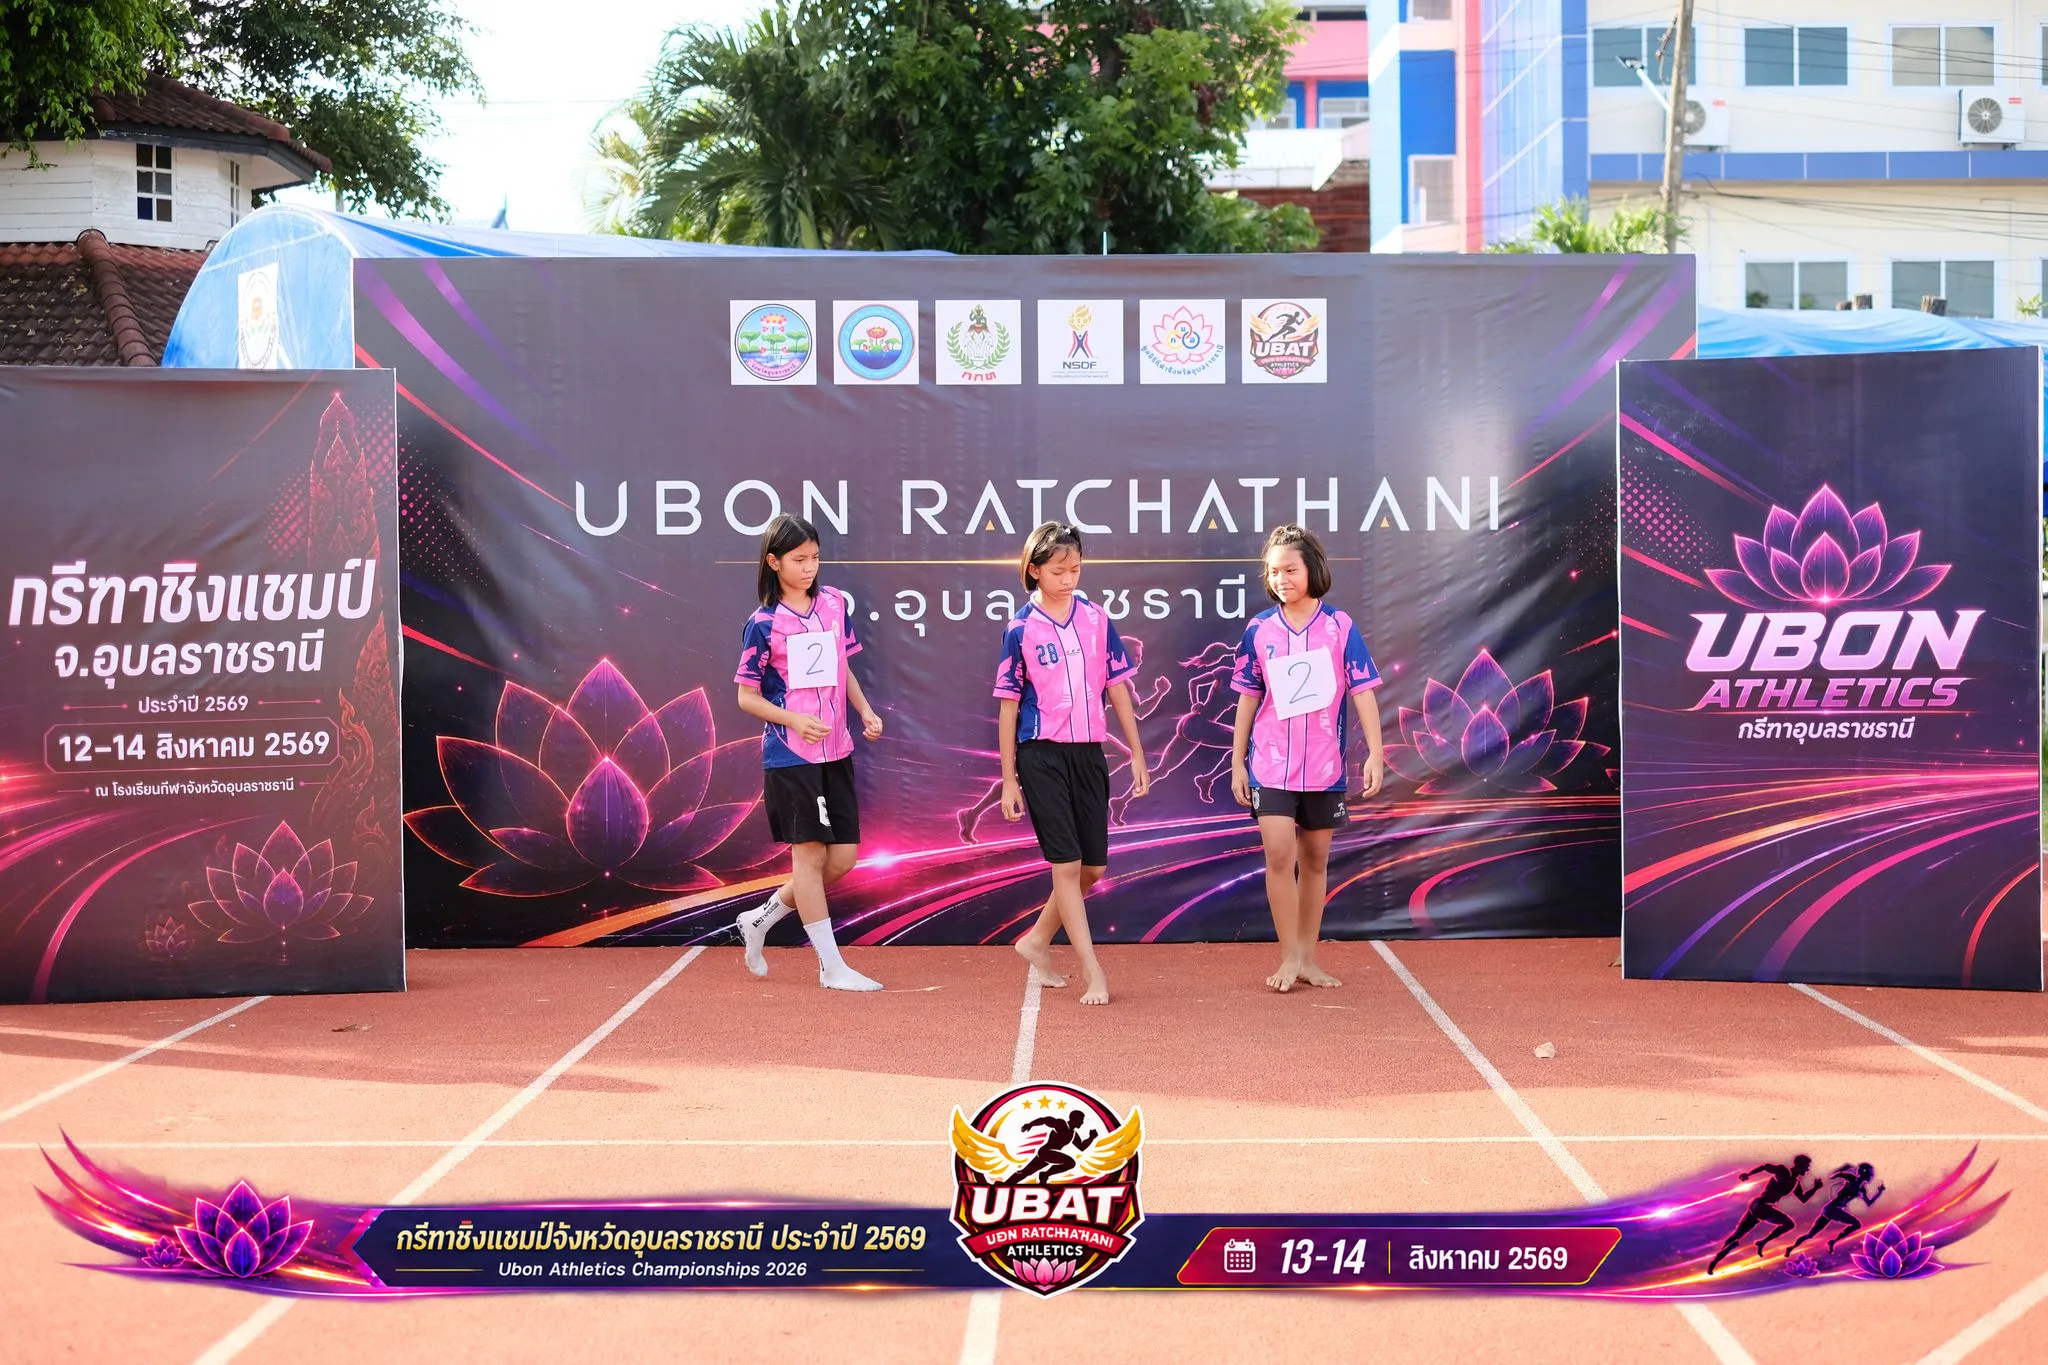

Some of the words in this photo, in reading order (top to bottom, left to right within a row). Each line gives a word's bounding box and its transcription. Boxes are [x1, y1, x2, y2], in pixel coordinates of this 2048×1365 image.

[1062, 361, 1097, 370] NSDF
[1255, 342, 1315, 357] UBAT
[575, 479, 848, 536] UBON
[902, 475, 1500, 536] RATCHATHANI
[8, 558, 376, 626] กรีฑาชิงแชมป์
[1035, 642, 1059, 666] 28
[1685, 609, 1987, 672] UBON
[54, 629, 325, 689] จ.อุบลราชธานี
[806, 642, 825, 676] 2
[1287, 661, 1318, 705] 2
[1690, 677, 1976, 711] ATHLETICS
[138, 694, 199, 714] ประจำปี
[205, 695, 249, 712] 2569
[156, 733, 255, 760] สิงหาคม
[264, 730, 330, 756] 2569
[1738, 716, 1916, 745] กรีฑาอุบลราชธานี
[95, 787, 109, 797] ณ
[112, 776, 294, 797] โรงเรียนกีฬาจังหวัดอุบลราชธานี
